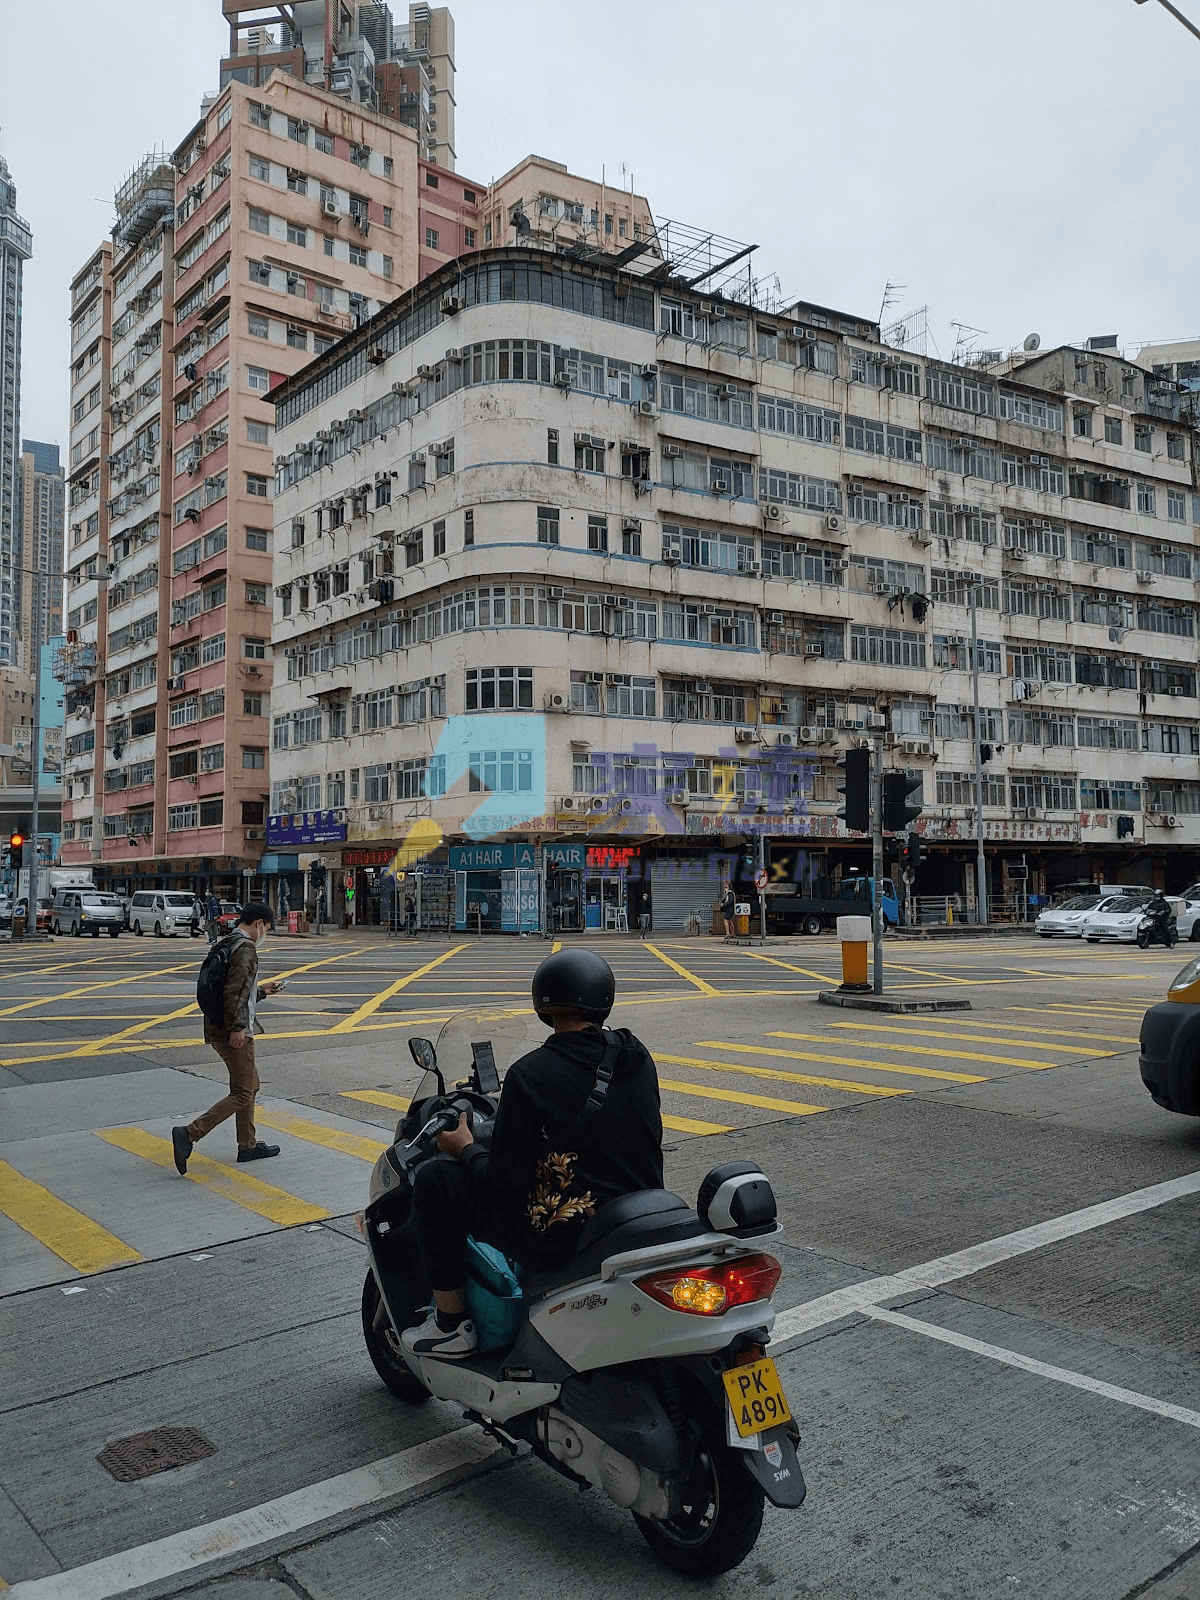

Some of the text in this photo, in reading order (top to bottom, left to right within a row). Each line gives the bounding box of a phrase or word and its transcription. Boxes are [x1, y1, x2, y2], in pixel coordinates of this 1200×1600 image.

[459, 850, 503, 866] A1 HAIR
[501, 894, 516, 911] $60
[737, 1369, 769, 1399] PK
[741, 1392, 786, 1428] 4891
[773, 1467, 791, 1482] SYM
